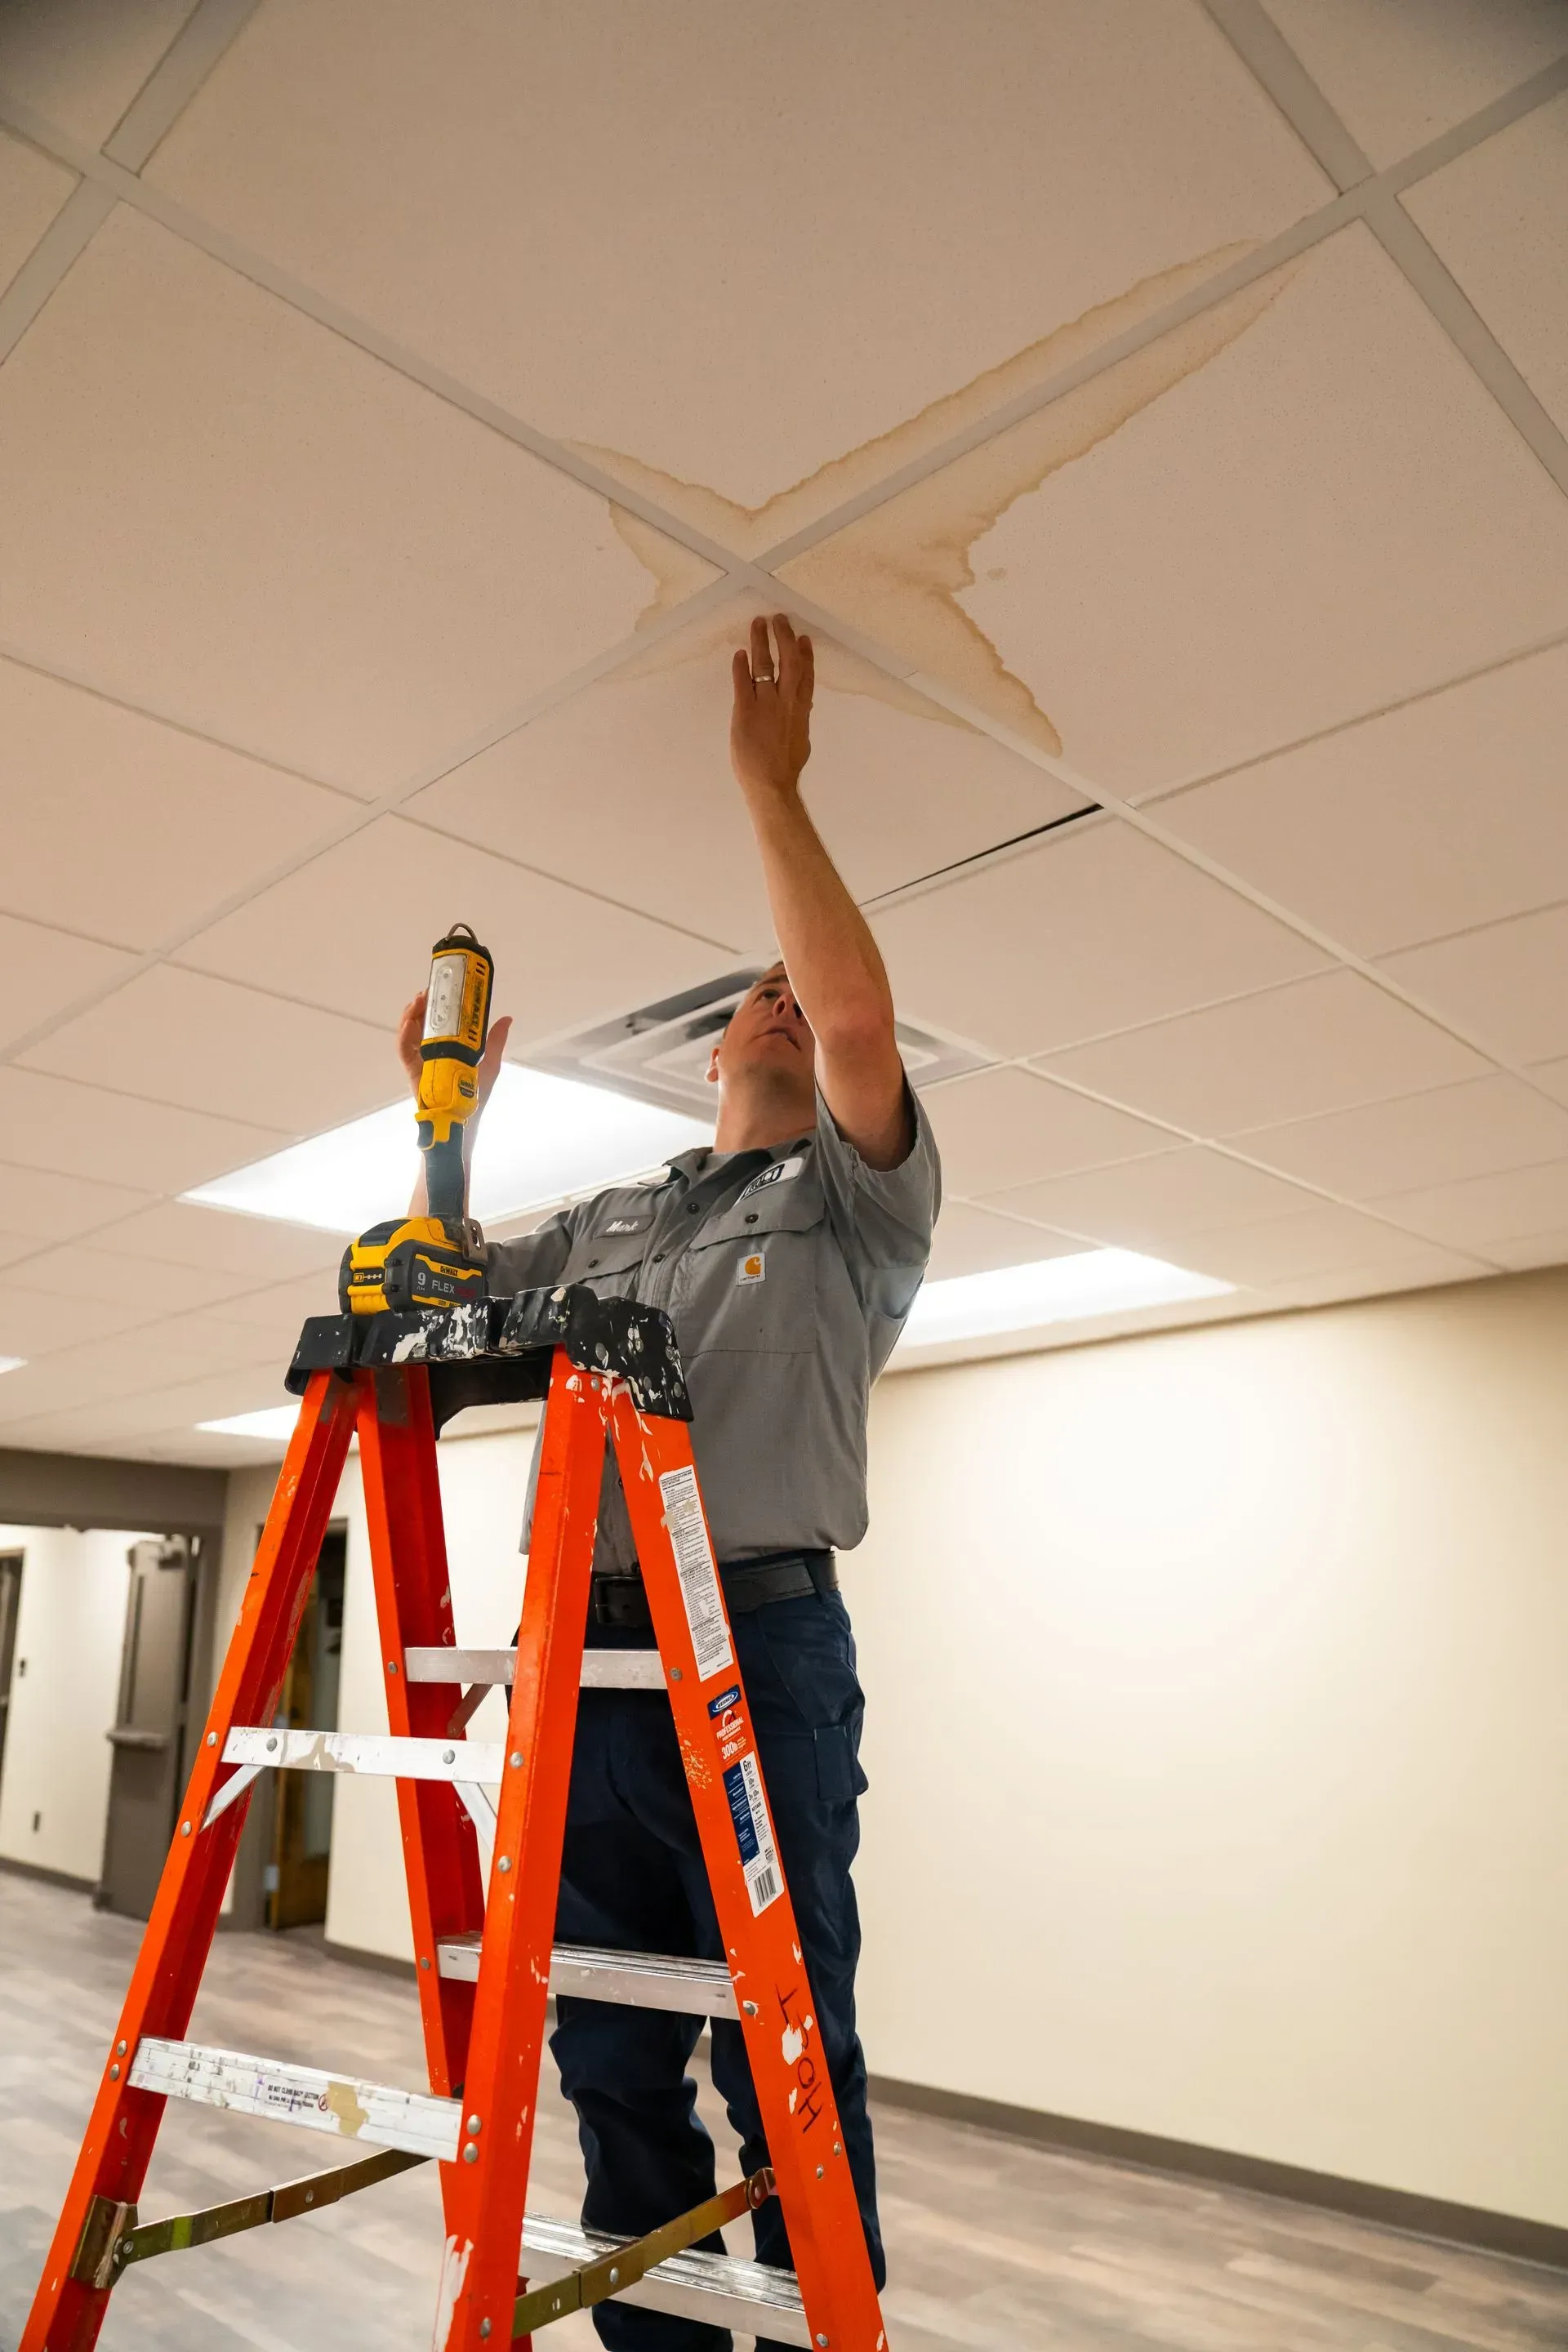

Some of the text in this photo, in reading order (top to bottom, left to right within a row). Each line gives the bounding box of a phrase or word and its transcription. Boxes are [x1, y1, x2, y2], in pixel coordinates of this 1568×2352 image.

[606, 1220, 639, 1232] Mark
[417, 1272, 426, 1285] 9
[716, 1716, 744, 1740] PROFESSIONAL
